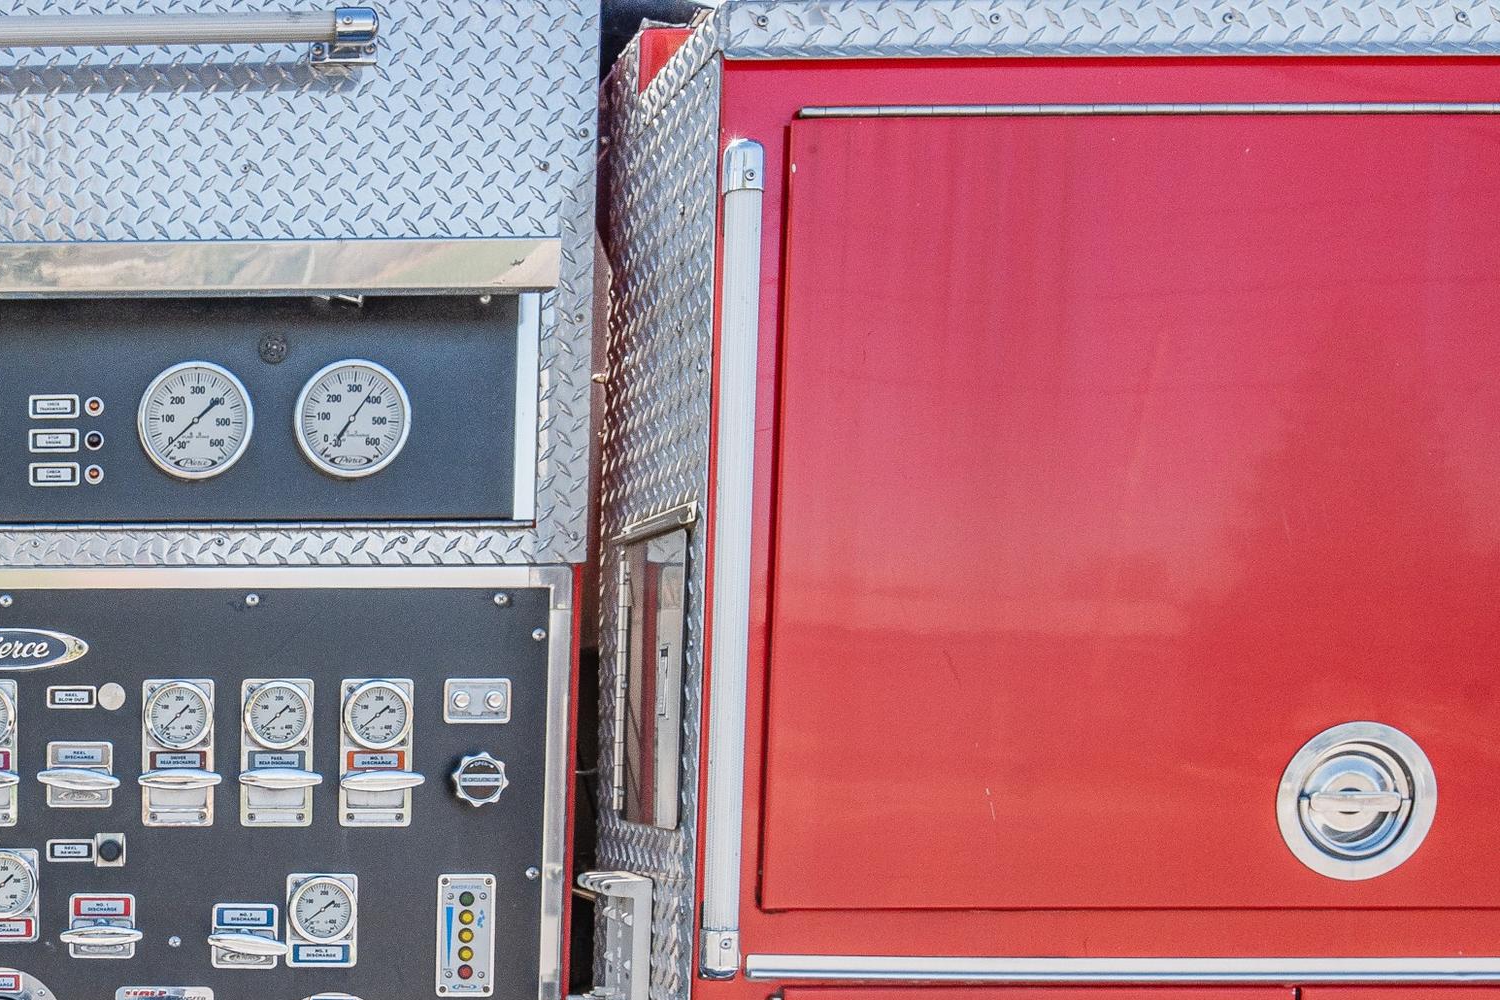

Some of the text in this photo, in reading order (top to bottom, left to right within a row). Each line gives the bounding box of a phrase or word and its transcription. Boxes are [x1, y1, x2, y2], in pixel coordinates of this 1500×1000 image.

[190, 386, 206, 395] 300
[347, 384, 362, 393] 300
[170, 396, 186, 405] 200
[326, 394, 342, 403] 200
[366, 396, 382, 404] 400
[161, 414, 175, 423] 100
[317, 412, 331, 420] 100
[372, 416, 387, 425] 500
[215, 418, 231, 426] 500
[209, 438, 225, 447] 600
[323, 434, 329, 442] 0
[365, 437, 380, 446] 600
